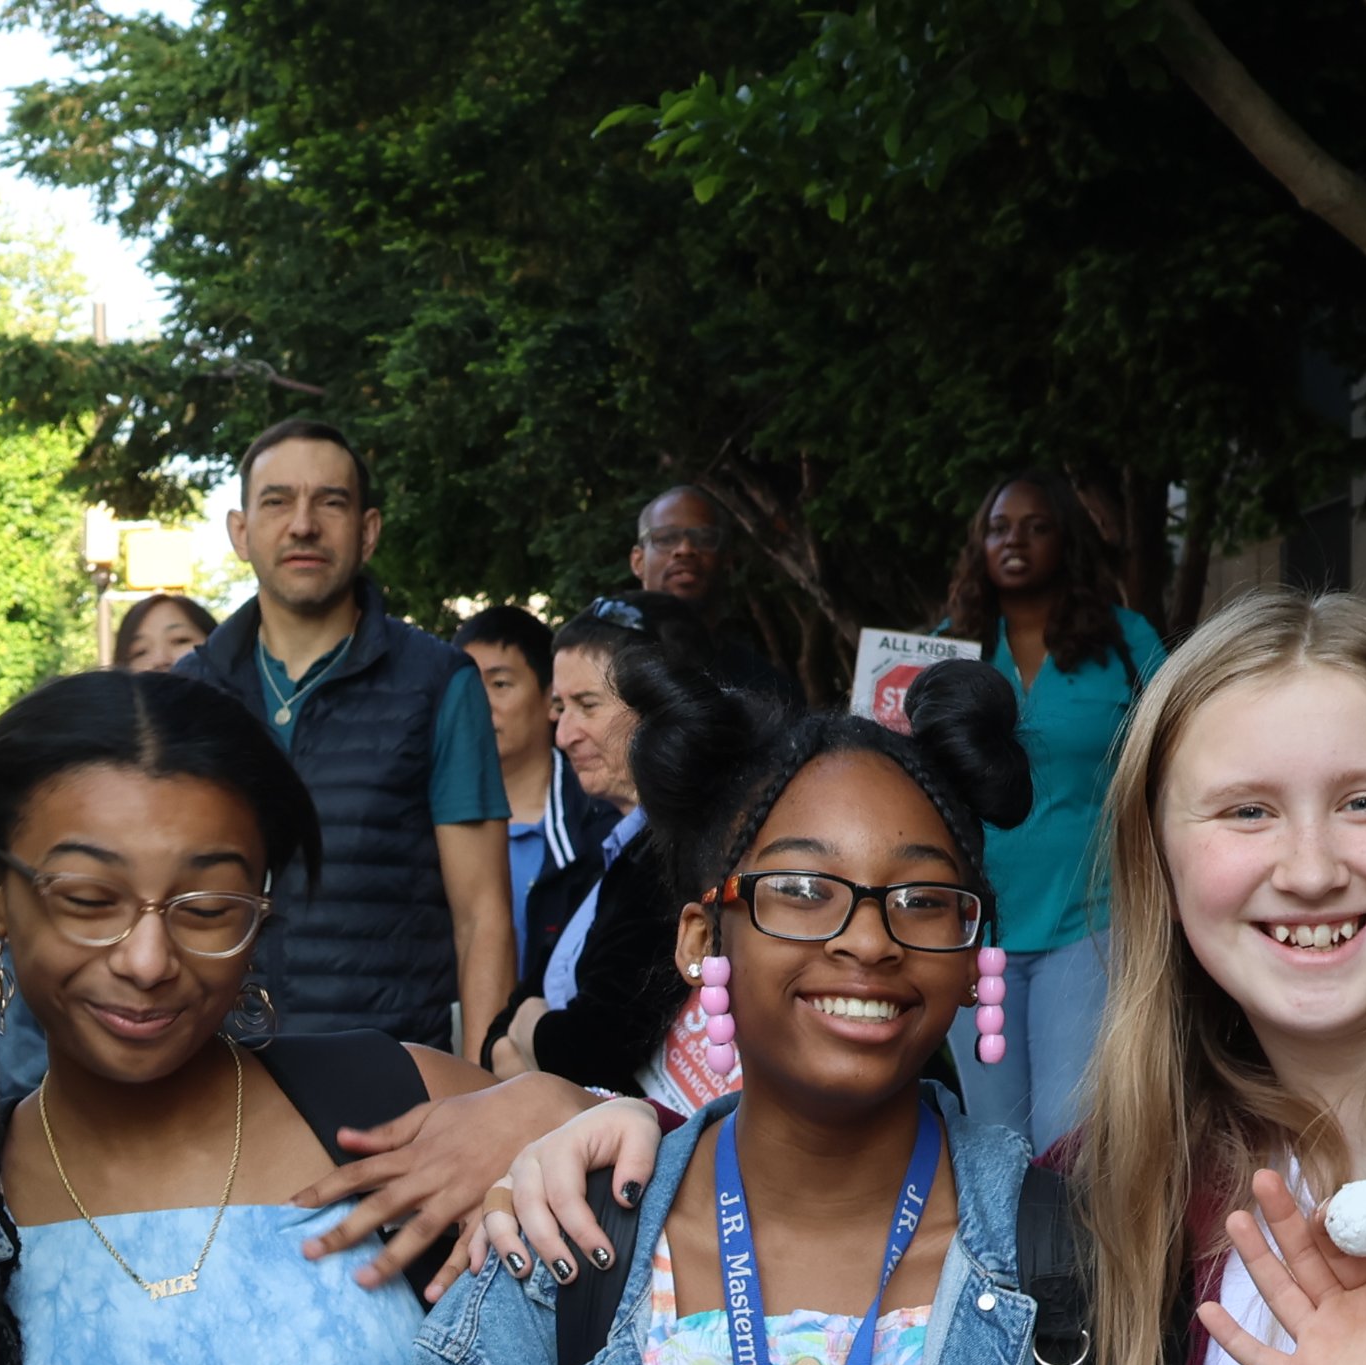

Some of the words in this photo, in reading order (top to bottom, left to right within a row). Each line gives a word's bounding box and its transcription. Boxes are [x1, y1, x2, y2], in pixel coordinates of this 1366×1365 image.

[879, 636, 911, 653] ALL
[917, 641, 958, 657] KIDS
[881, 686, 909, 713] ST
[719, 1191, 746, 1245] J.R.
[896, 1183, 924, 1235] J.R.
